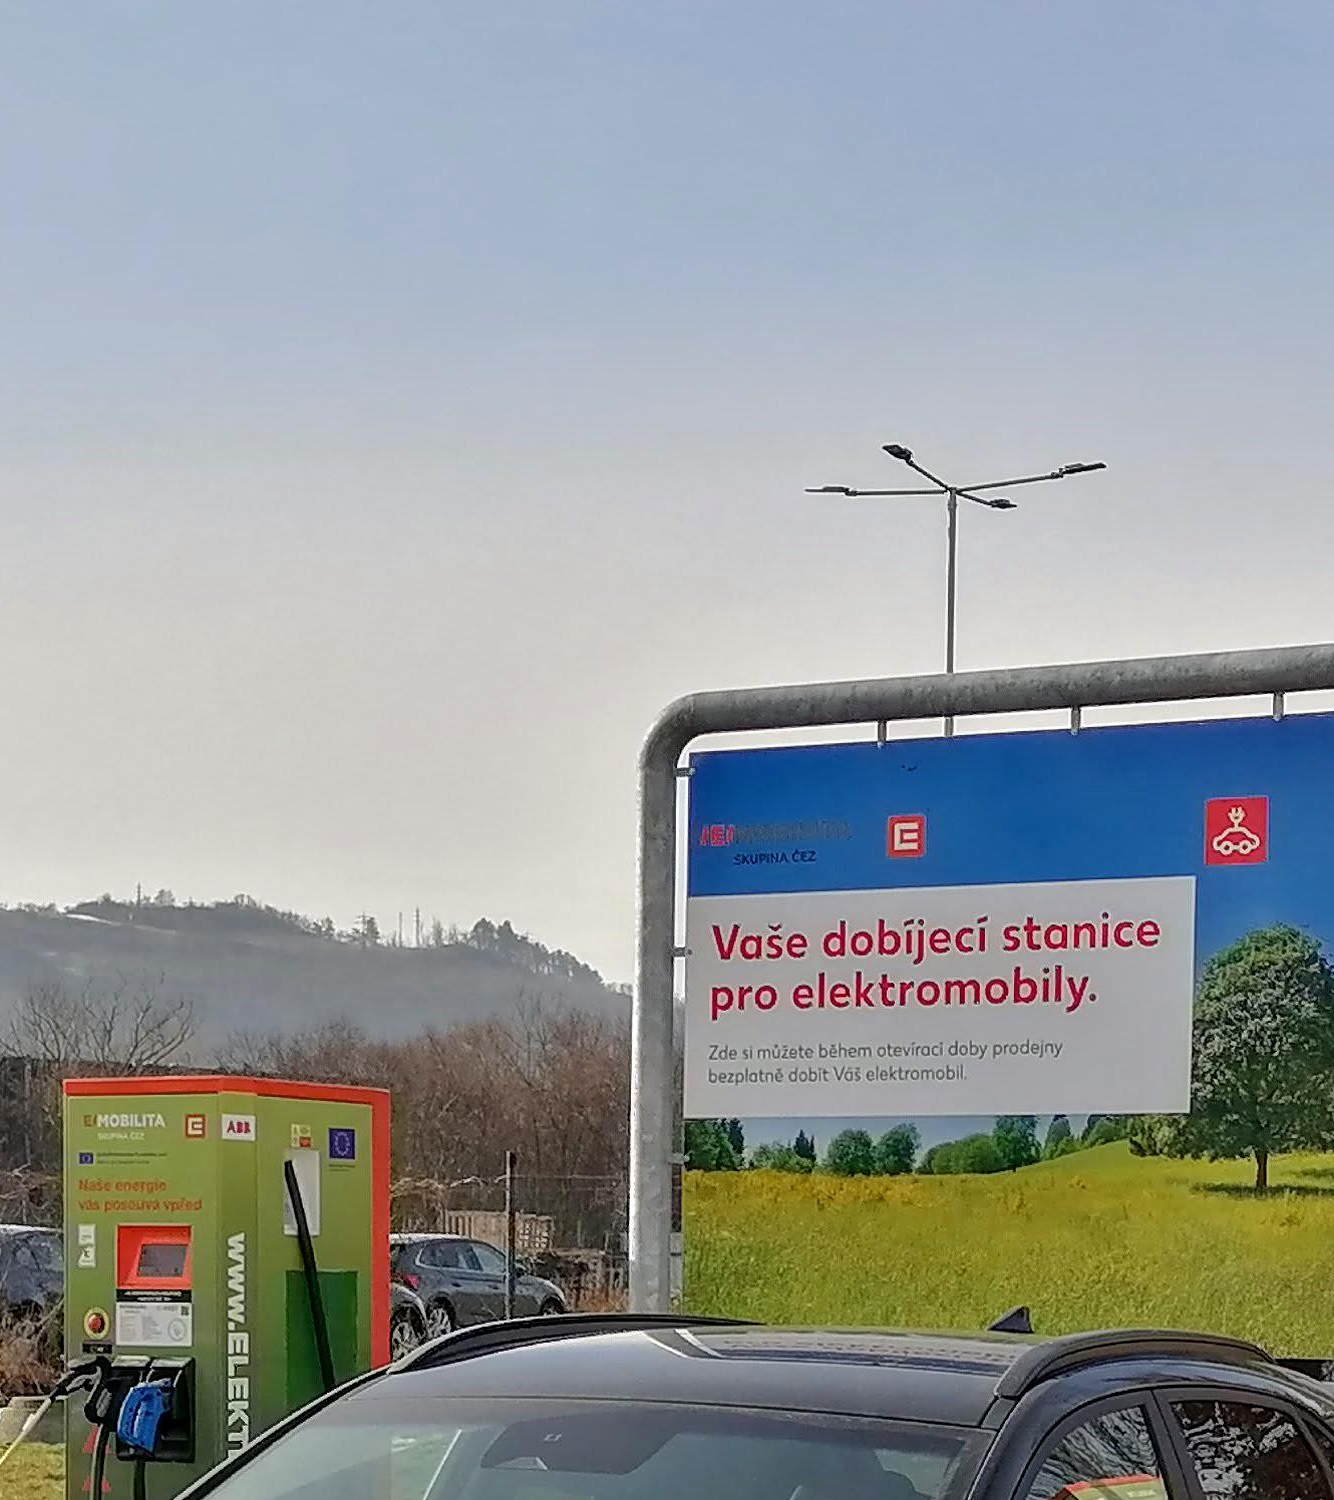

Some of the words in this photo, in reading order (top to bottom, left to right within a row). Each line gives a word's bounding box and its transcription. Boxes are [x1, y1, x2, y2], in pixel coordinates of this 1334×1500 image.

[733, 852, 788, 866] SKUPINA
[791, 849, 818, 863] ČEZ
[712, 922, 808, 961] Vaše
[822, 914, 990, 966] dobíjecí
[1002, 911, 1161, 952] stanice
[709, 982, 778, 1021] pro
[792, 965, 1098, 1013] elektromobily.
[708, 1044, 738, 1061] Zde
[742, 1045, 754, 1060] si
[757, 1043, 815, 1060] můžete
[818, 1042, 873, 1059] během
[876, 1041, 945, 1058] otevírací
[947, 1039, 988, 1060] doby
[992, 1038, 1064, 1059] prodejny
[708, 1067, 784, 1086] bezplatně
[787, 1066, 831, 1083] dobít
[833, 1065, 862, 1082] Váš
[866, 1064, 967, 1082] elektromobil.
[227, 1121, 251, 1134] ABB
